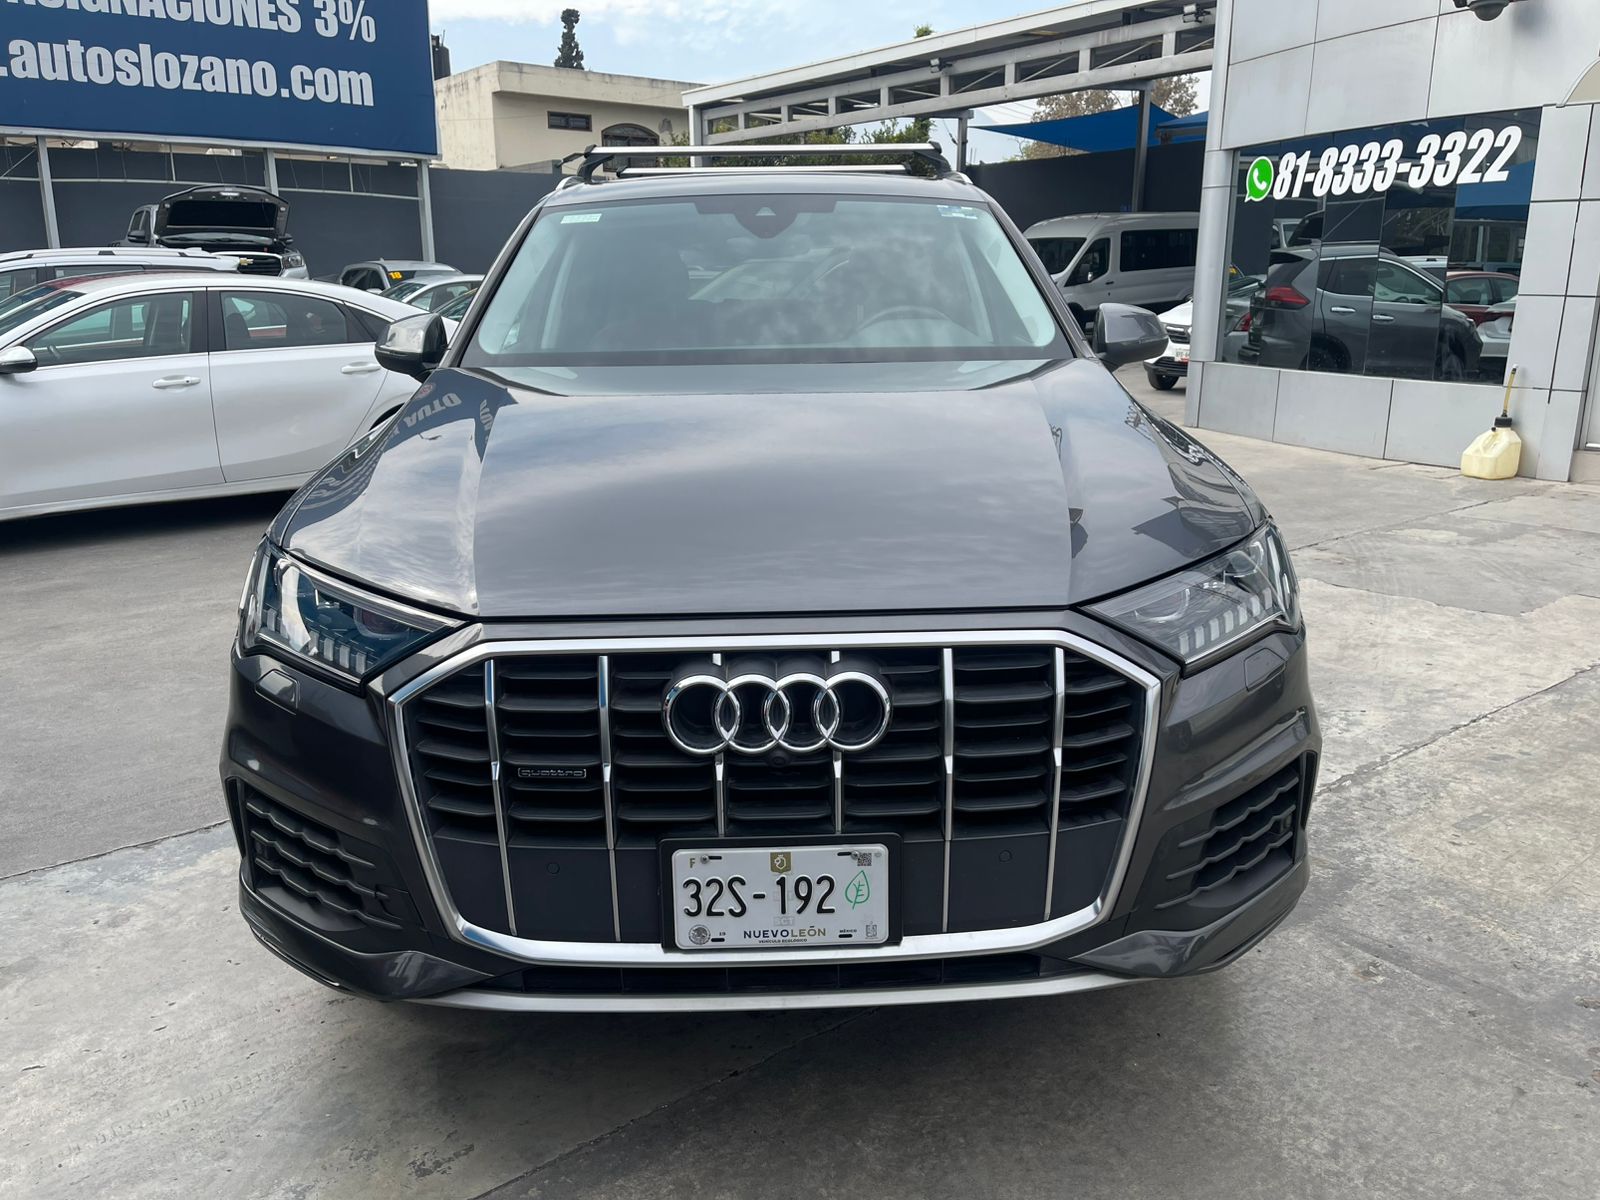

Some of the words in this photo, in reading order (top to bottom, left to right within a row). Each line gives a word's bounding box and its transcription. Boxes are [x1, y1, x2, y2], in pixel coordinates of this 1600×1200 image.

[6, 0, 301, 33] ACIONES
[313, 0, 377, 43] 3%
[1272, 125, 1523, 200] 81-8333-3322
[520, 768, 584, 777] quattro
[689, 857, 696, 869] F
[682, 874, 836, 918] 32S-192
